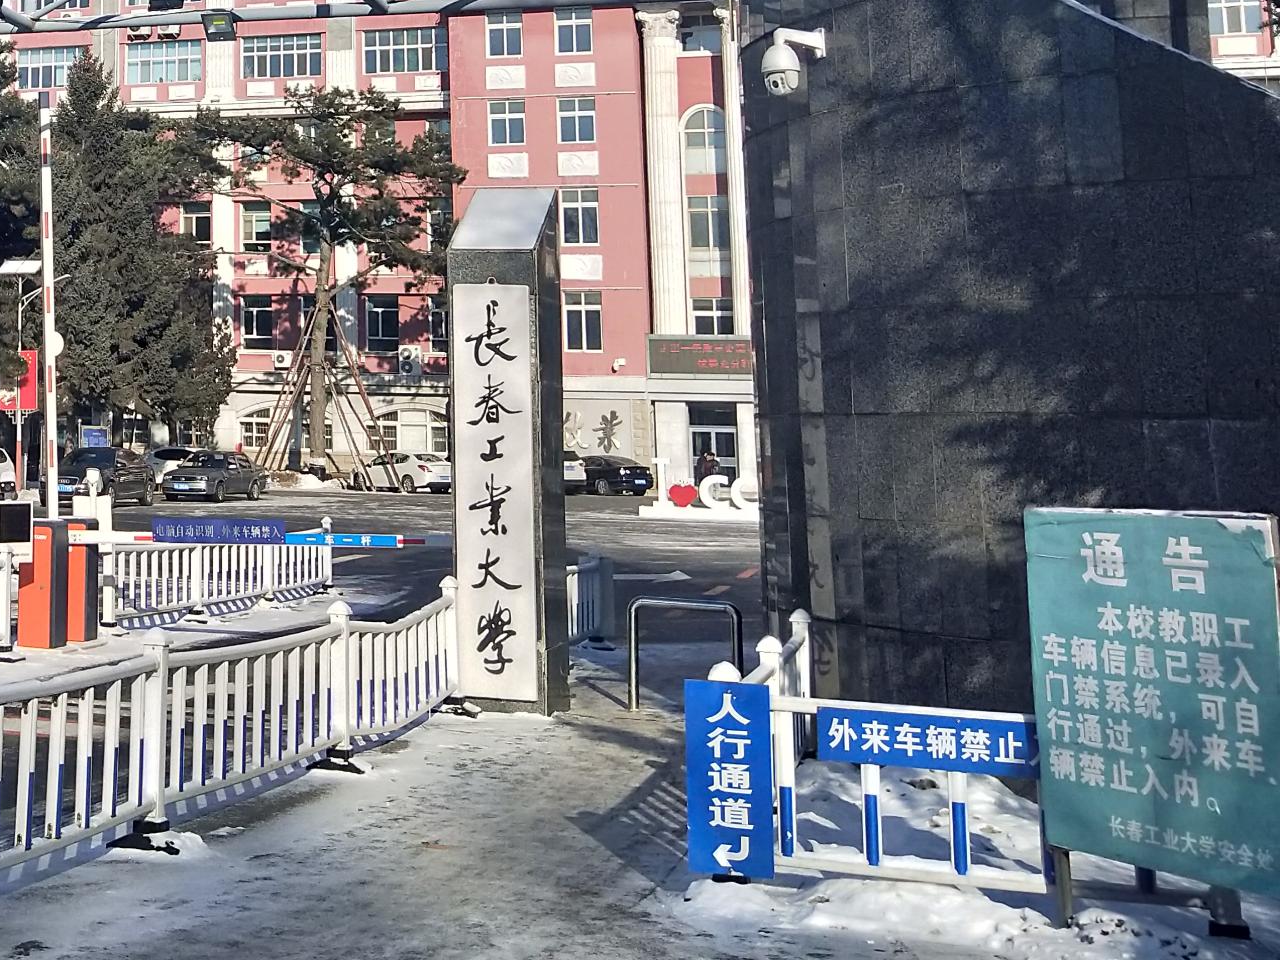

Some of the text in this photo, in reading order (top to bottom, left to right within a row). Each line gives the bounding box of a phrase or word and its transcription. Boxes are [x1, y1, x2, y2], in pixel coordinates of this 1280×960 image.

[156, 524, 281, 538] 电脑自动识别 外来车辆禁入
[305, 534, 372, 546] 一车一杆
[1080, 532, 1209, 594] 通告
[1097, 601, 1254, 649] 本校教职工
[1042, 633, 1260, 693] 车辆信息已录入
[1045, 671, 1260, 737] 门禁系统，可自
[706, 690, 754, 830] 人行通道
[1109, 815, 1273, 871] 长春工业大学安全处
